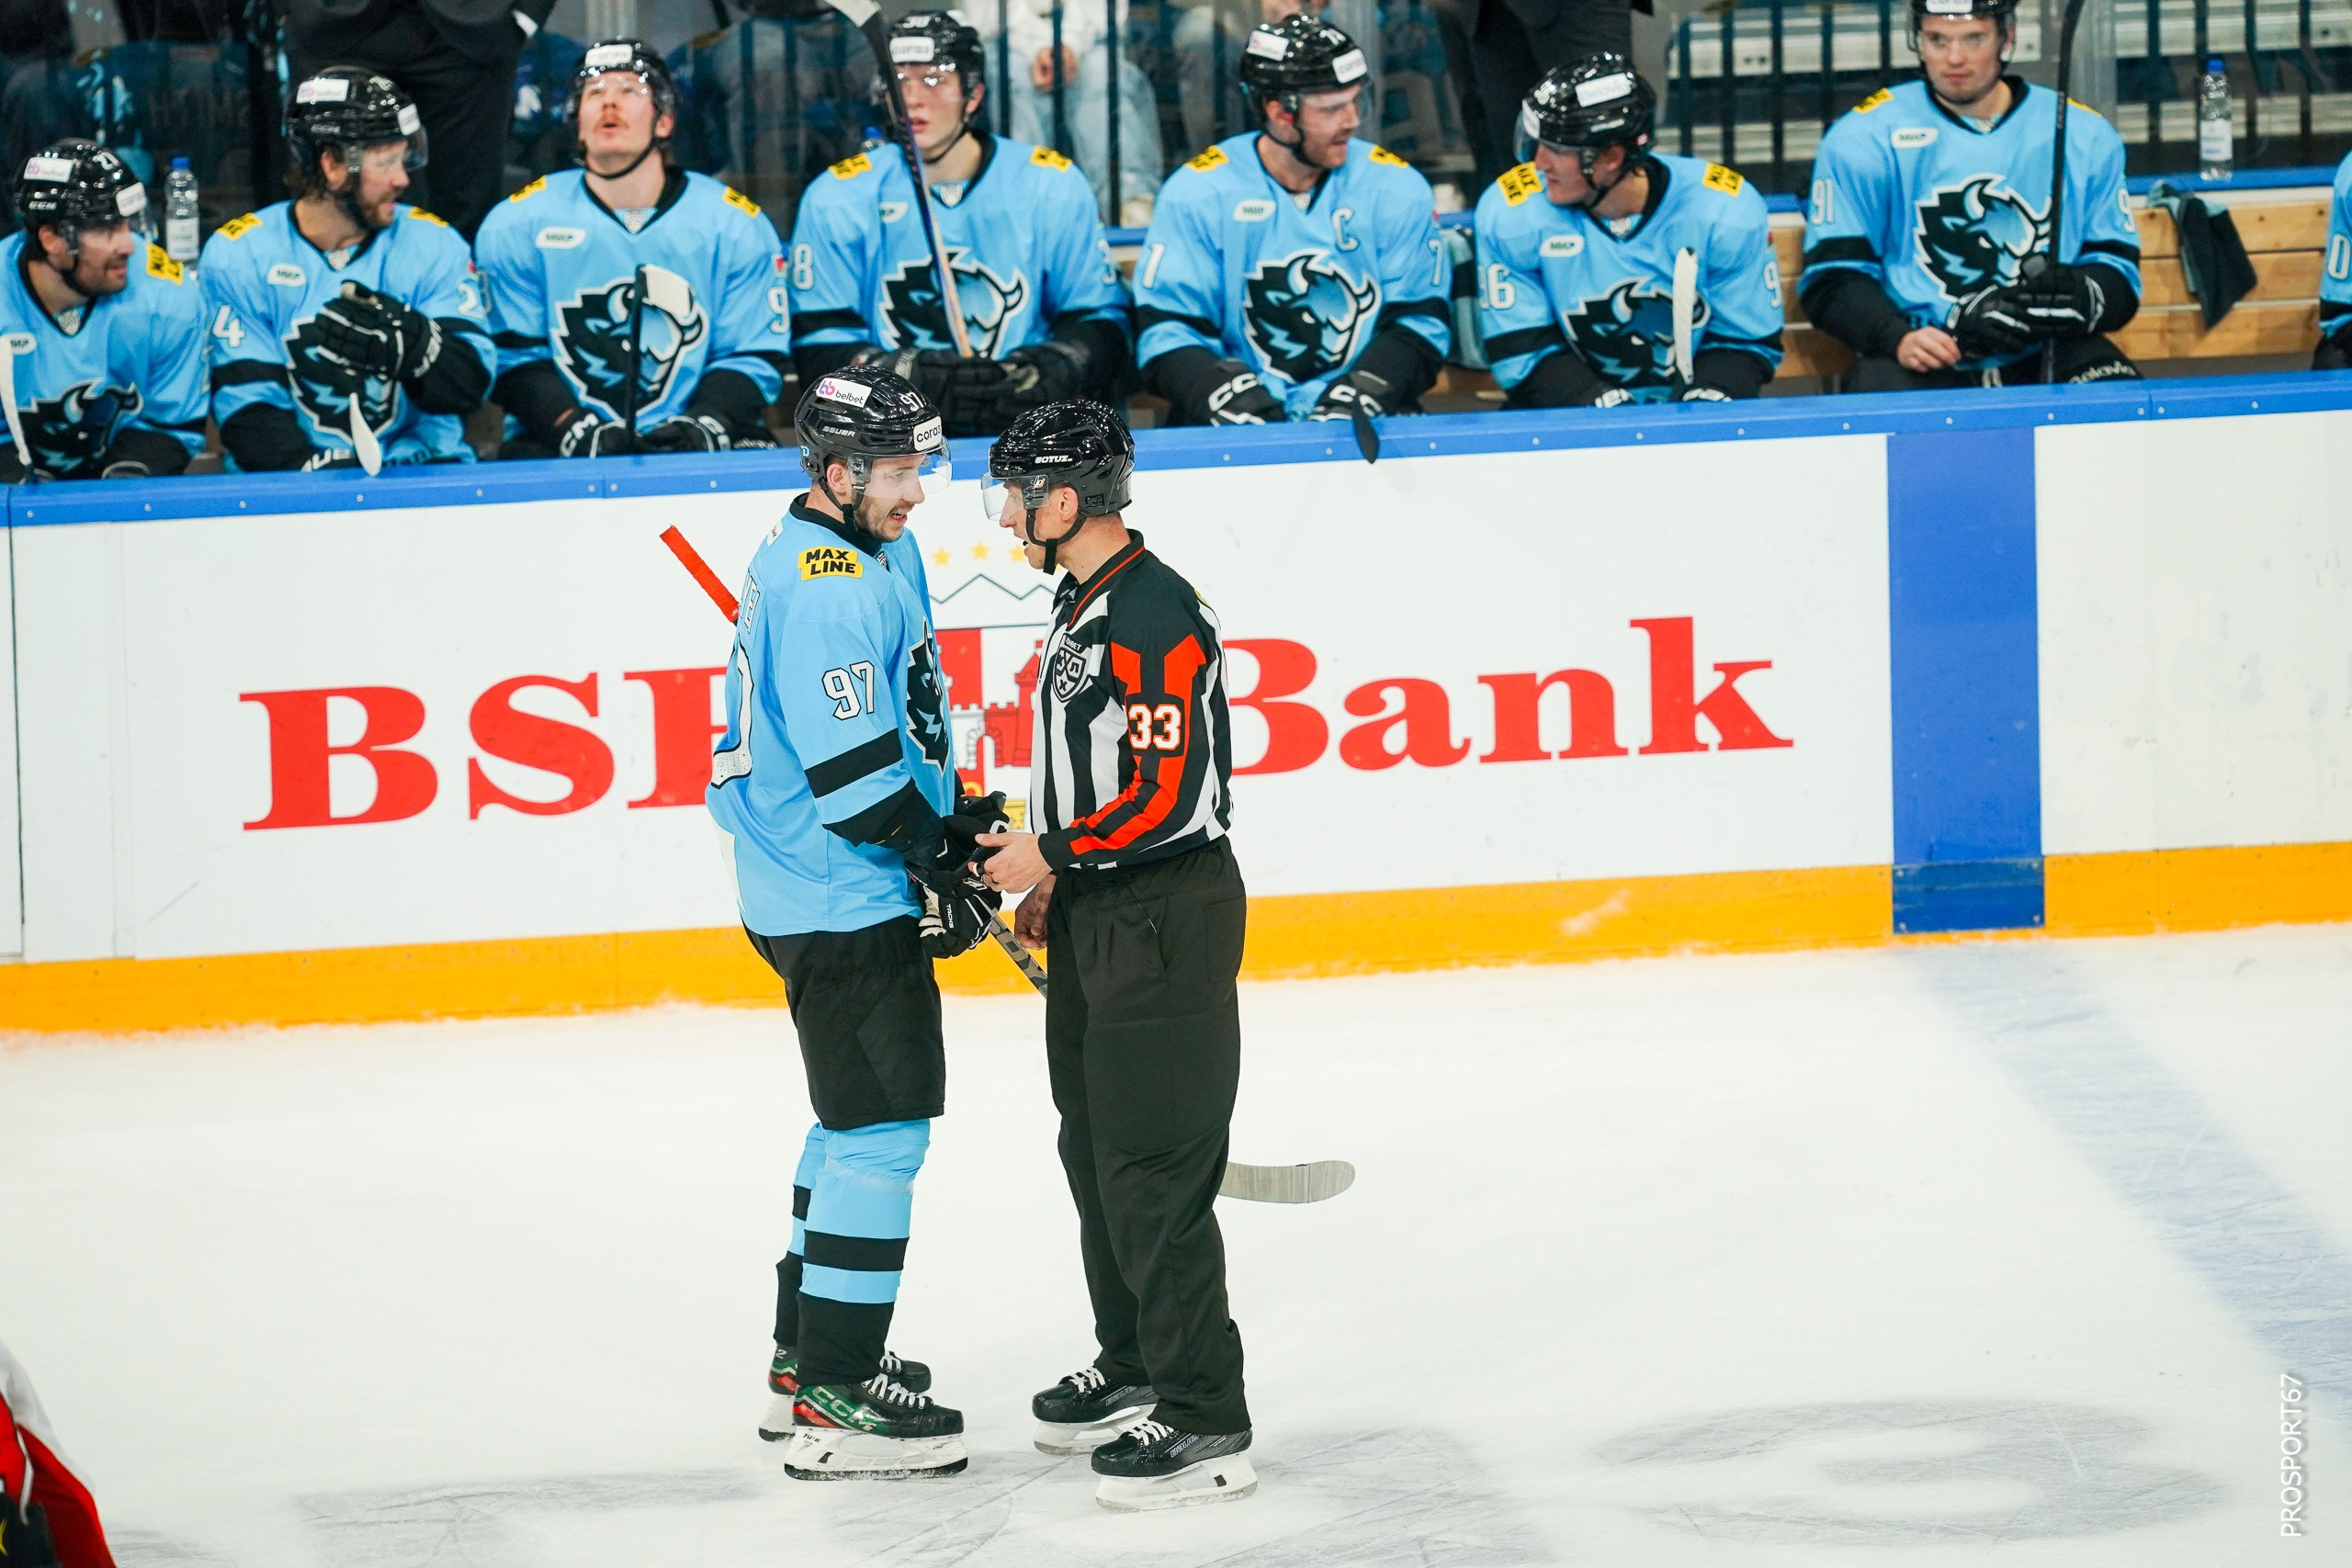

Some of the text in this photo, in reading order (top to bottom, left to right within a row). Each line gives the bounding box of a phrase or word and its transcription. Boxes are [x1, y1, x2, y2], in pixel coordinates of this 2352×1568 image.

[1811, 180, 1835, 225] 91
[1334, 208, 1360, 252] C
[793, 243, 814, 290] 8
[212, 305, 245, 347] 4
[767, 287, 790, 333] 9
[835, 389, 865, 405] belbet
[899, 391, 926, 412] 97
[805, 548, 849, 565] MAX
[809, 560, 856, 576] LINE
[822, 660, 876, 720] 97
[1222, 615, 1795, 777] Bank
[1127, 703, 1182, 750] 33
[945, 903, 956, 929] TACKS
[811, 1385, 877, 1431] CCM
